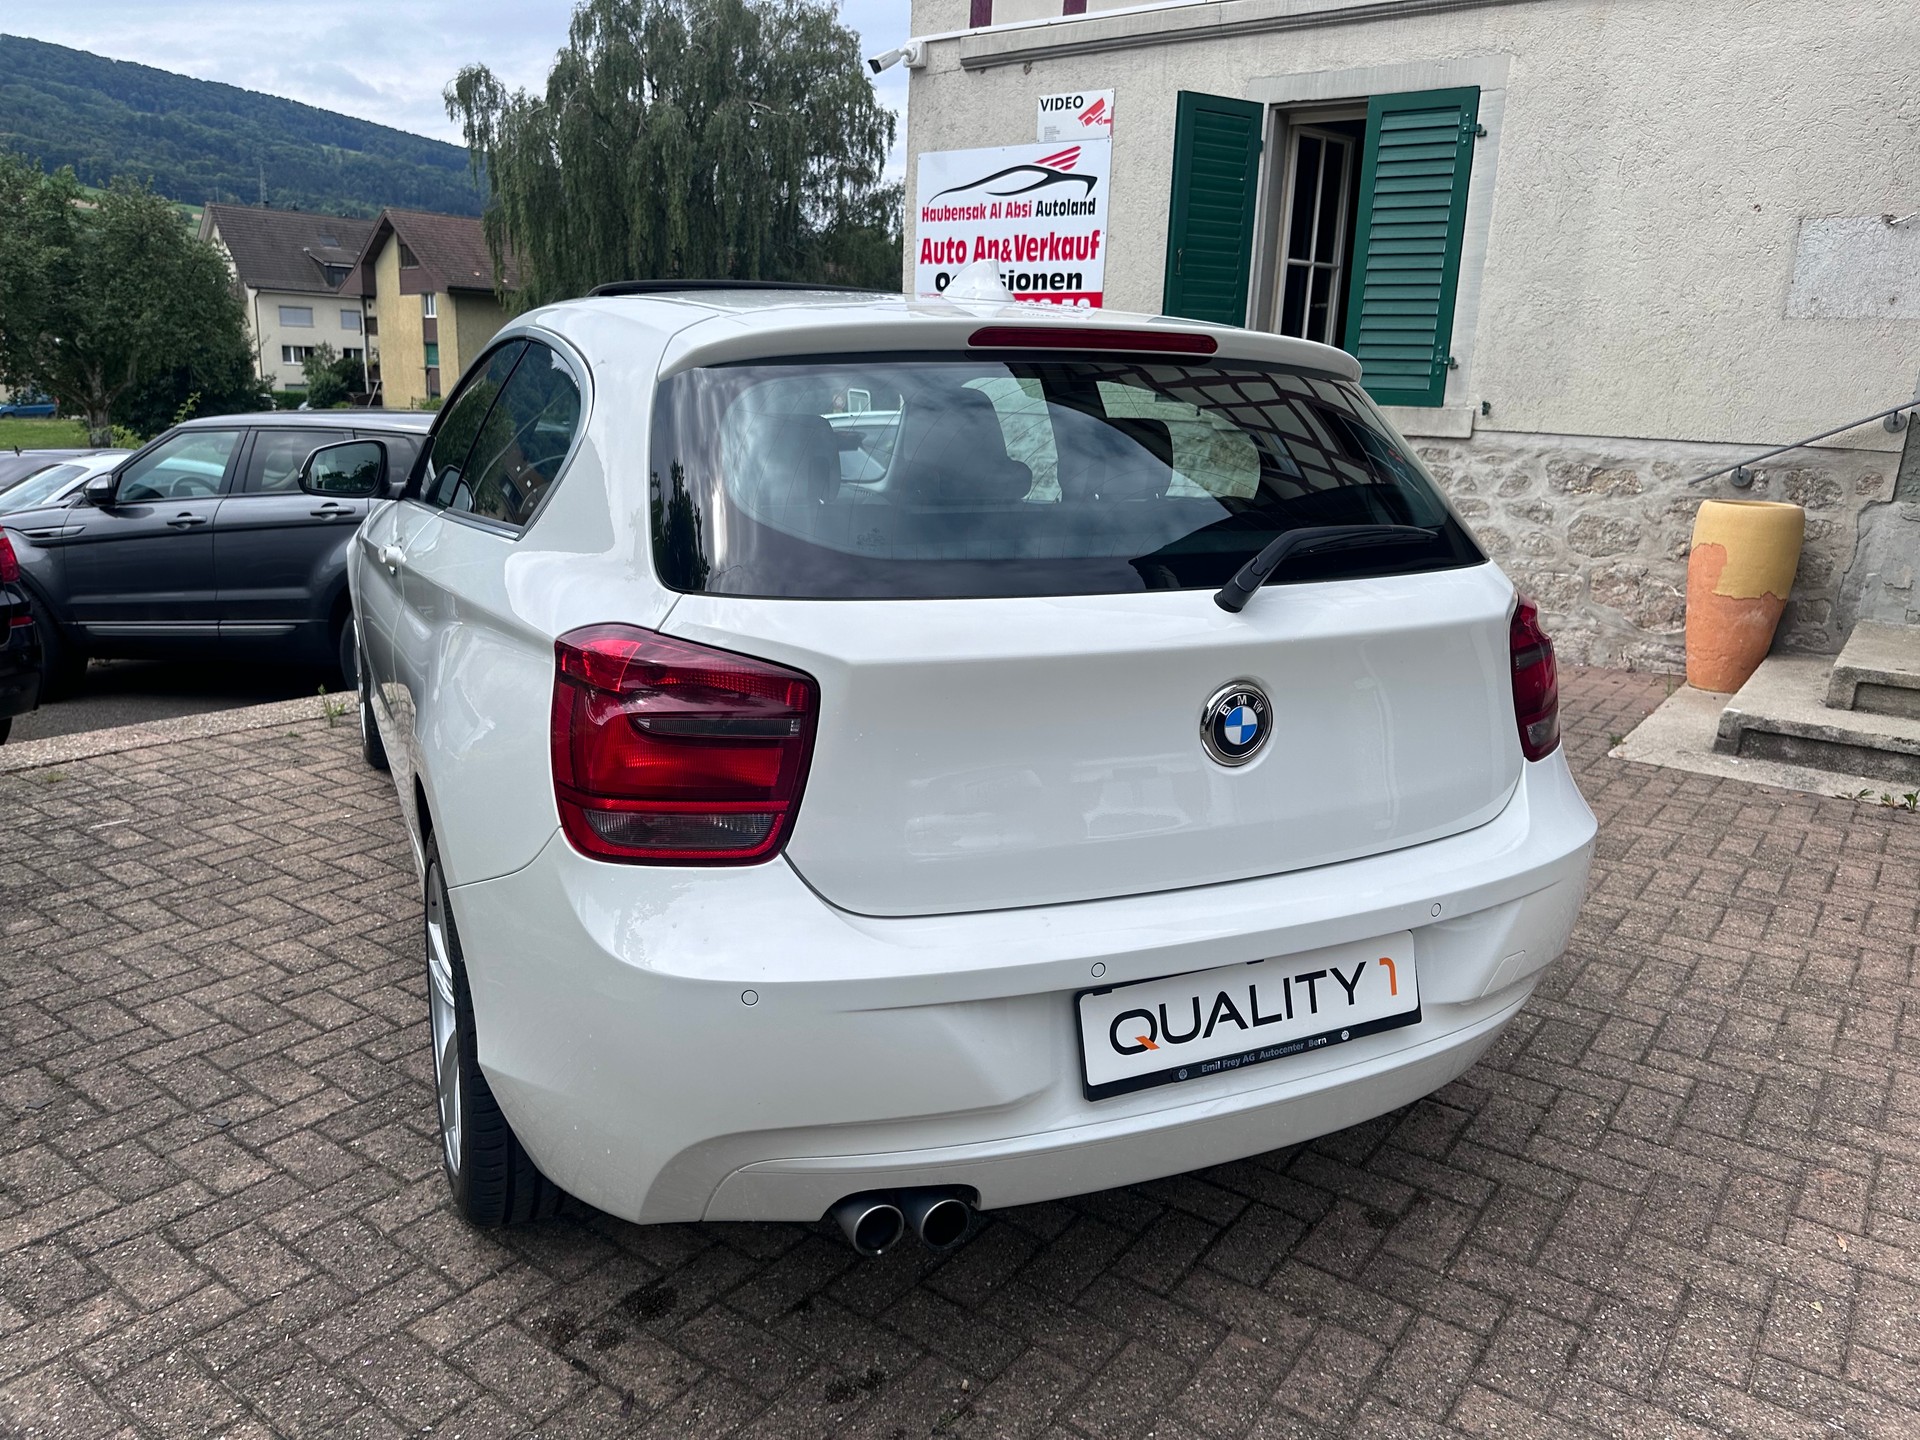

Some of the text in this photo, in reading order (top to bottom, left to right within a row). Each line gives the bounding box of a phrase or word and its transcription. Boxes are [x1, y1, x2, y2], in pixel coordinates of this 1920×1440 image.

[1040, 95, 1084, 112] VIDEO
[922, 203, 987, 223] Haubensak
[1005, 200, 1032, 219] Absi
[1035, 198, 1096, 217] Autoland
[920, 230, 1101, 265] Auto An&Verkauf
[935, 270, 1083, 292] Oionen
[1220, 695, 1263, 716] BMW
[1109, 961, 1367, 1056] QUALITY
[1201, 1037, 1327, 1073] Emil Frey AG Autocenter Bern
